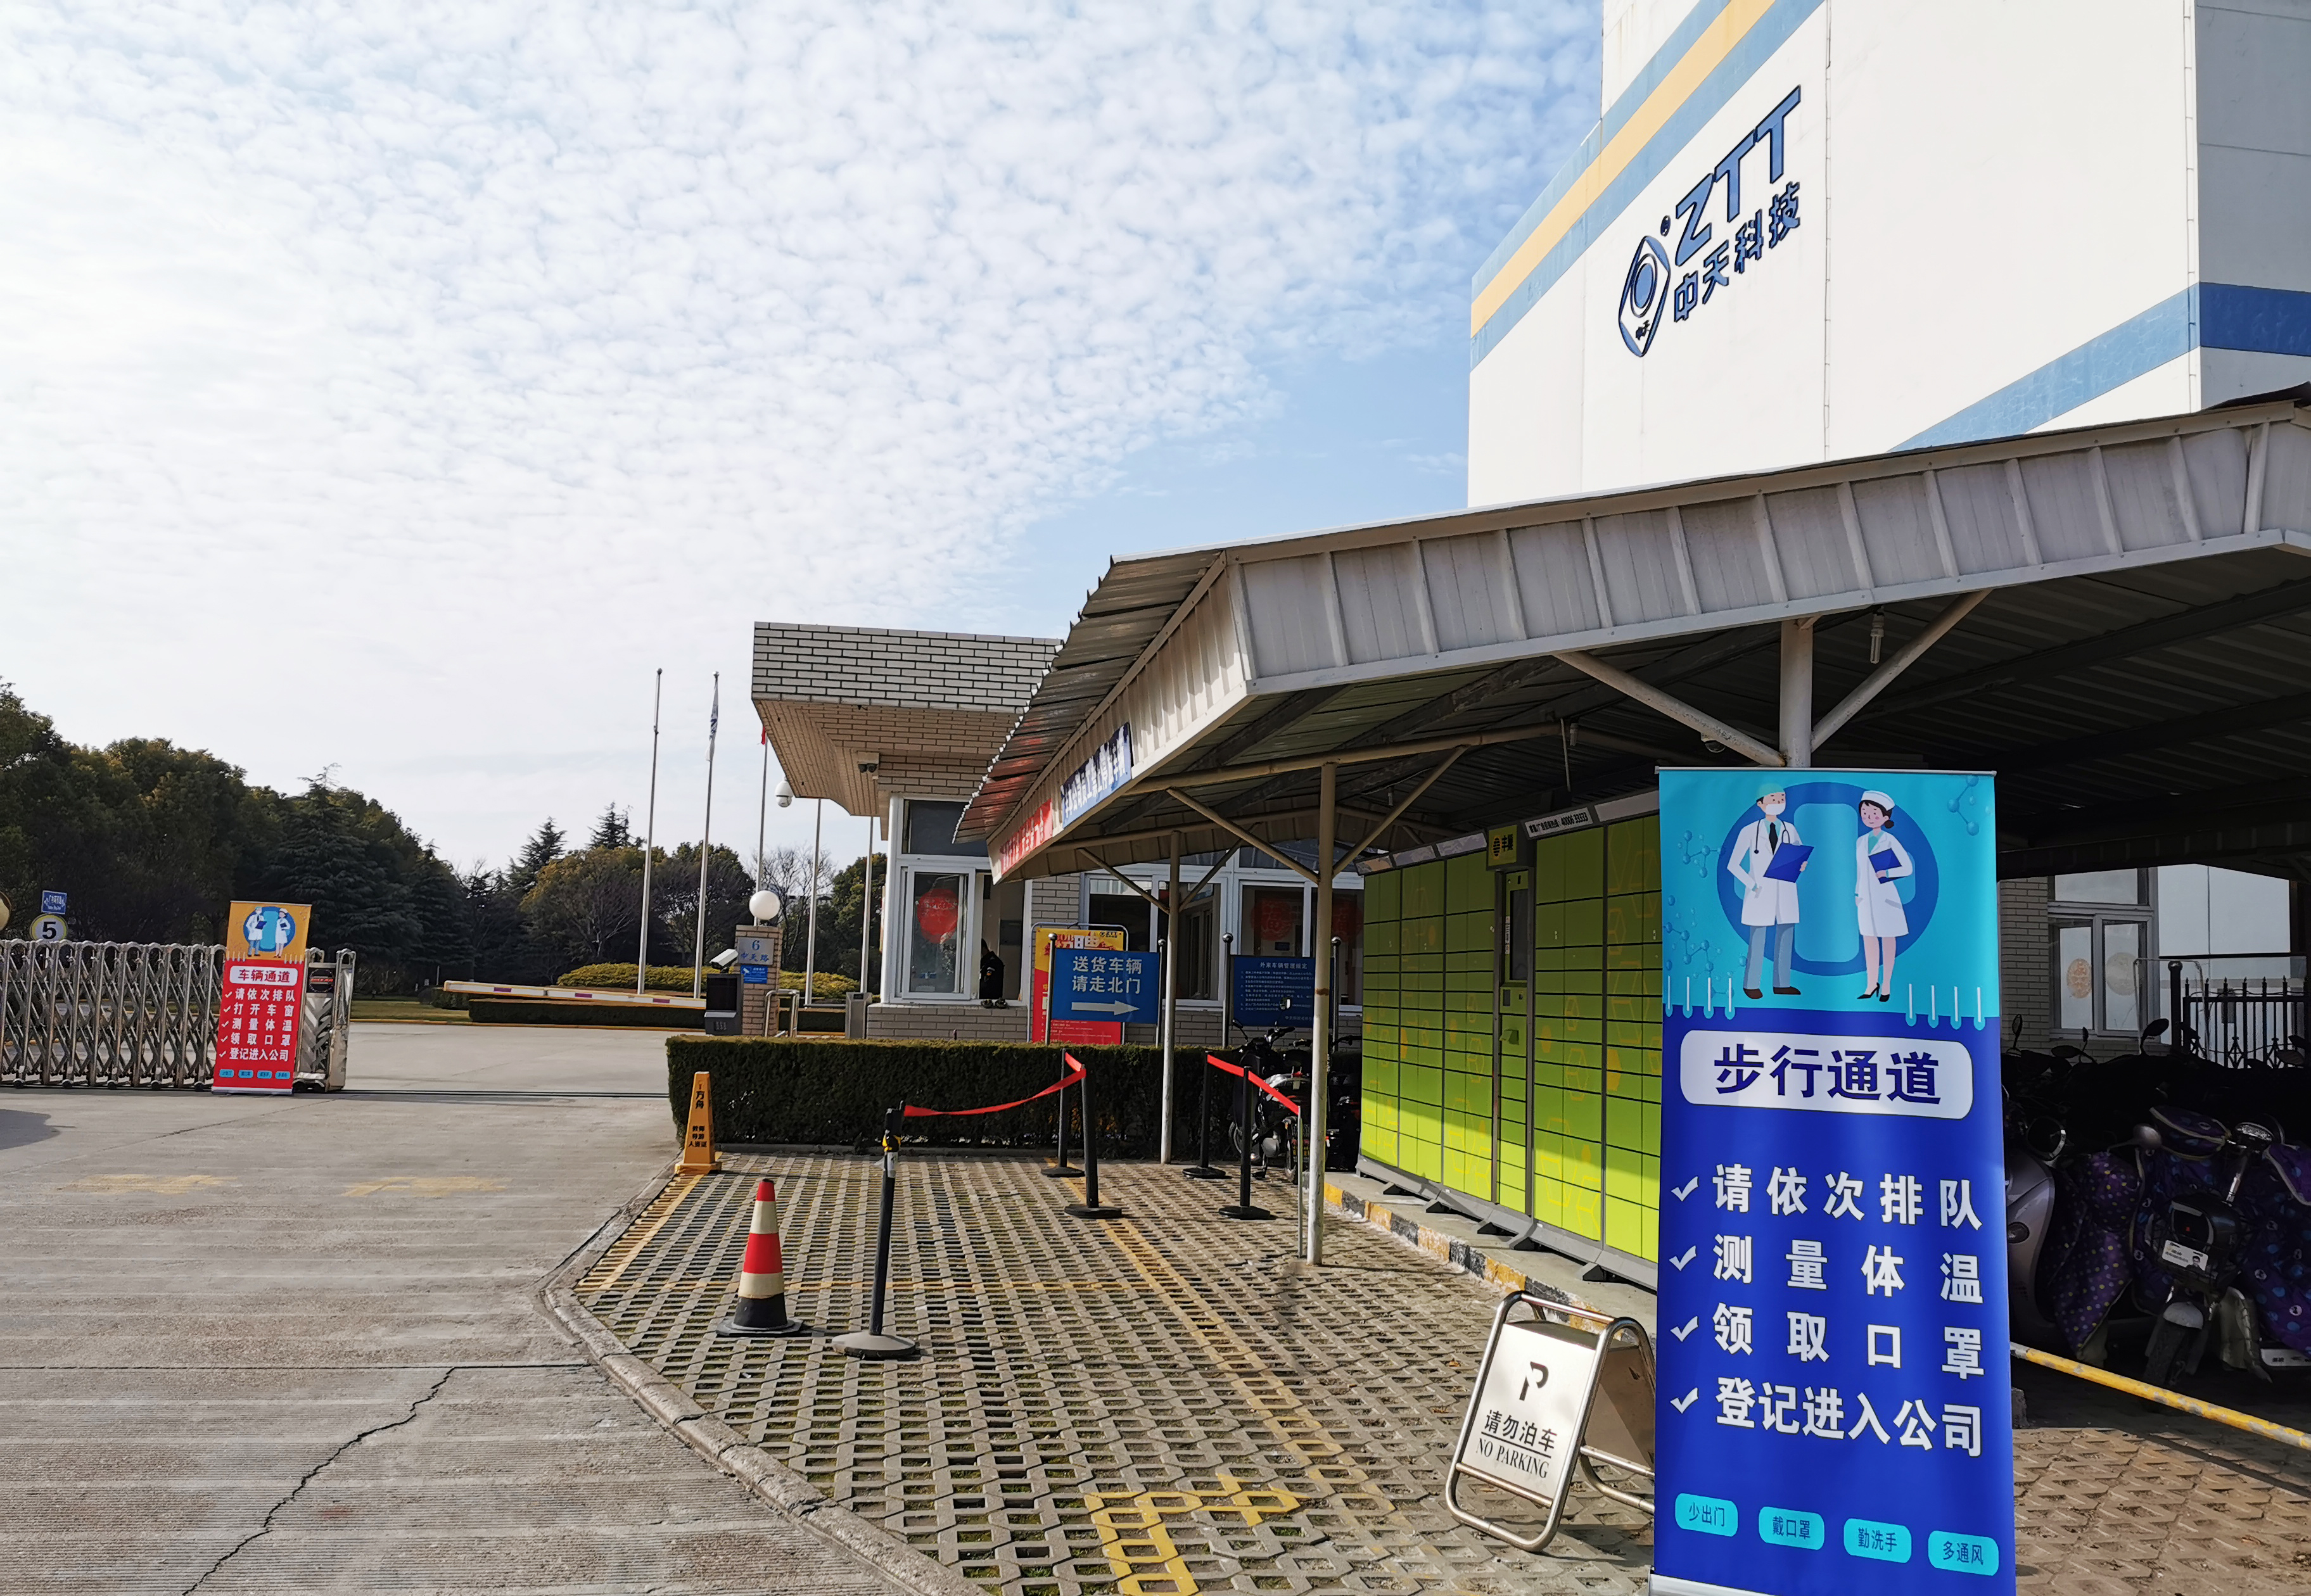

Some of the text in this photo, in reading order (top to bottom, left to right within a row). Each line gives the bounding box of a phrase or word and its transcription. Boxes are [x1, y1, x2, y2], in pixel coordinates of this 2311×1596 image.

[1676, 84, 1801, 267] ZTT
[1674, 181, 1800, 322] 中天科技
[42, 922, 56, 939] 5
[752, 940, 760, 951] 6
[741, 953, 770, 962] 中天路
[1073, 956, 1142, 975] 送货车辆
[238, 969, 290, 983] 车辆通道
[1072, 975, 1140, 994] 请走北门
[235, 987, 295, 1001] 请依次排队
[234, 1002, 294, 1017] 打开车窗
[232, 1018, 292, 1032] 测量体温
[231, 1032, 291, 1046] 领取口罩
[229, 1048, 289, 1061] 登记进入公司
[1714, 1043, 1941, 1105] 步行通道
[1712, 1163, 1983, 1231] 请依次排队
[1712, 1233, 1983, 1303] 测量体温
[1712, 1302, 1985, 1379] 领取口罩
[1716, 1378, 1982, 1457] 登记进入公司
[1484, 1409, 1558, 1452] 请勿泊车
[1476, 1438, 1550, 1479] NO PARKING
[1689, 1502, 1984, 1565] 少出门 戴口罩 勤洗手 多通风
